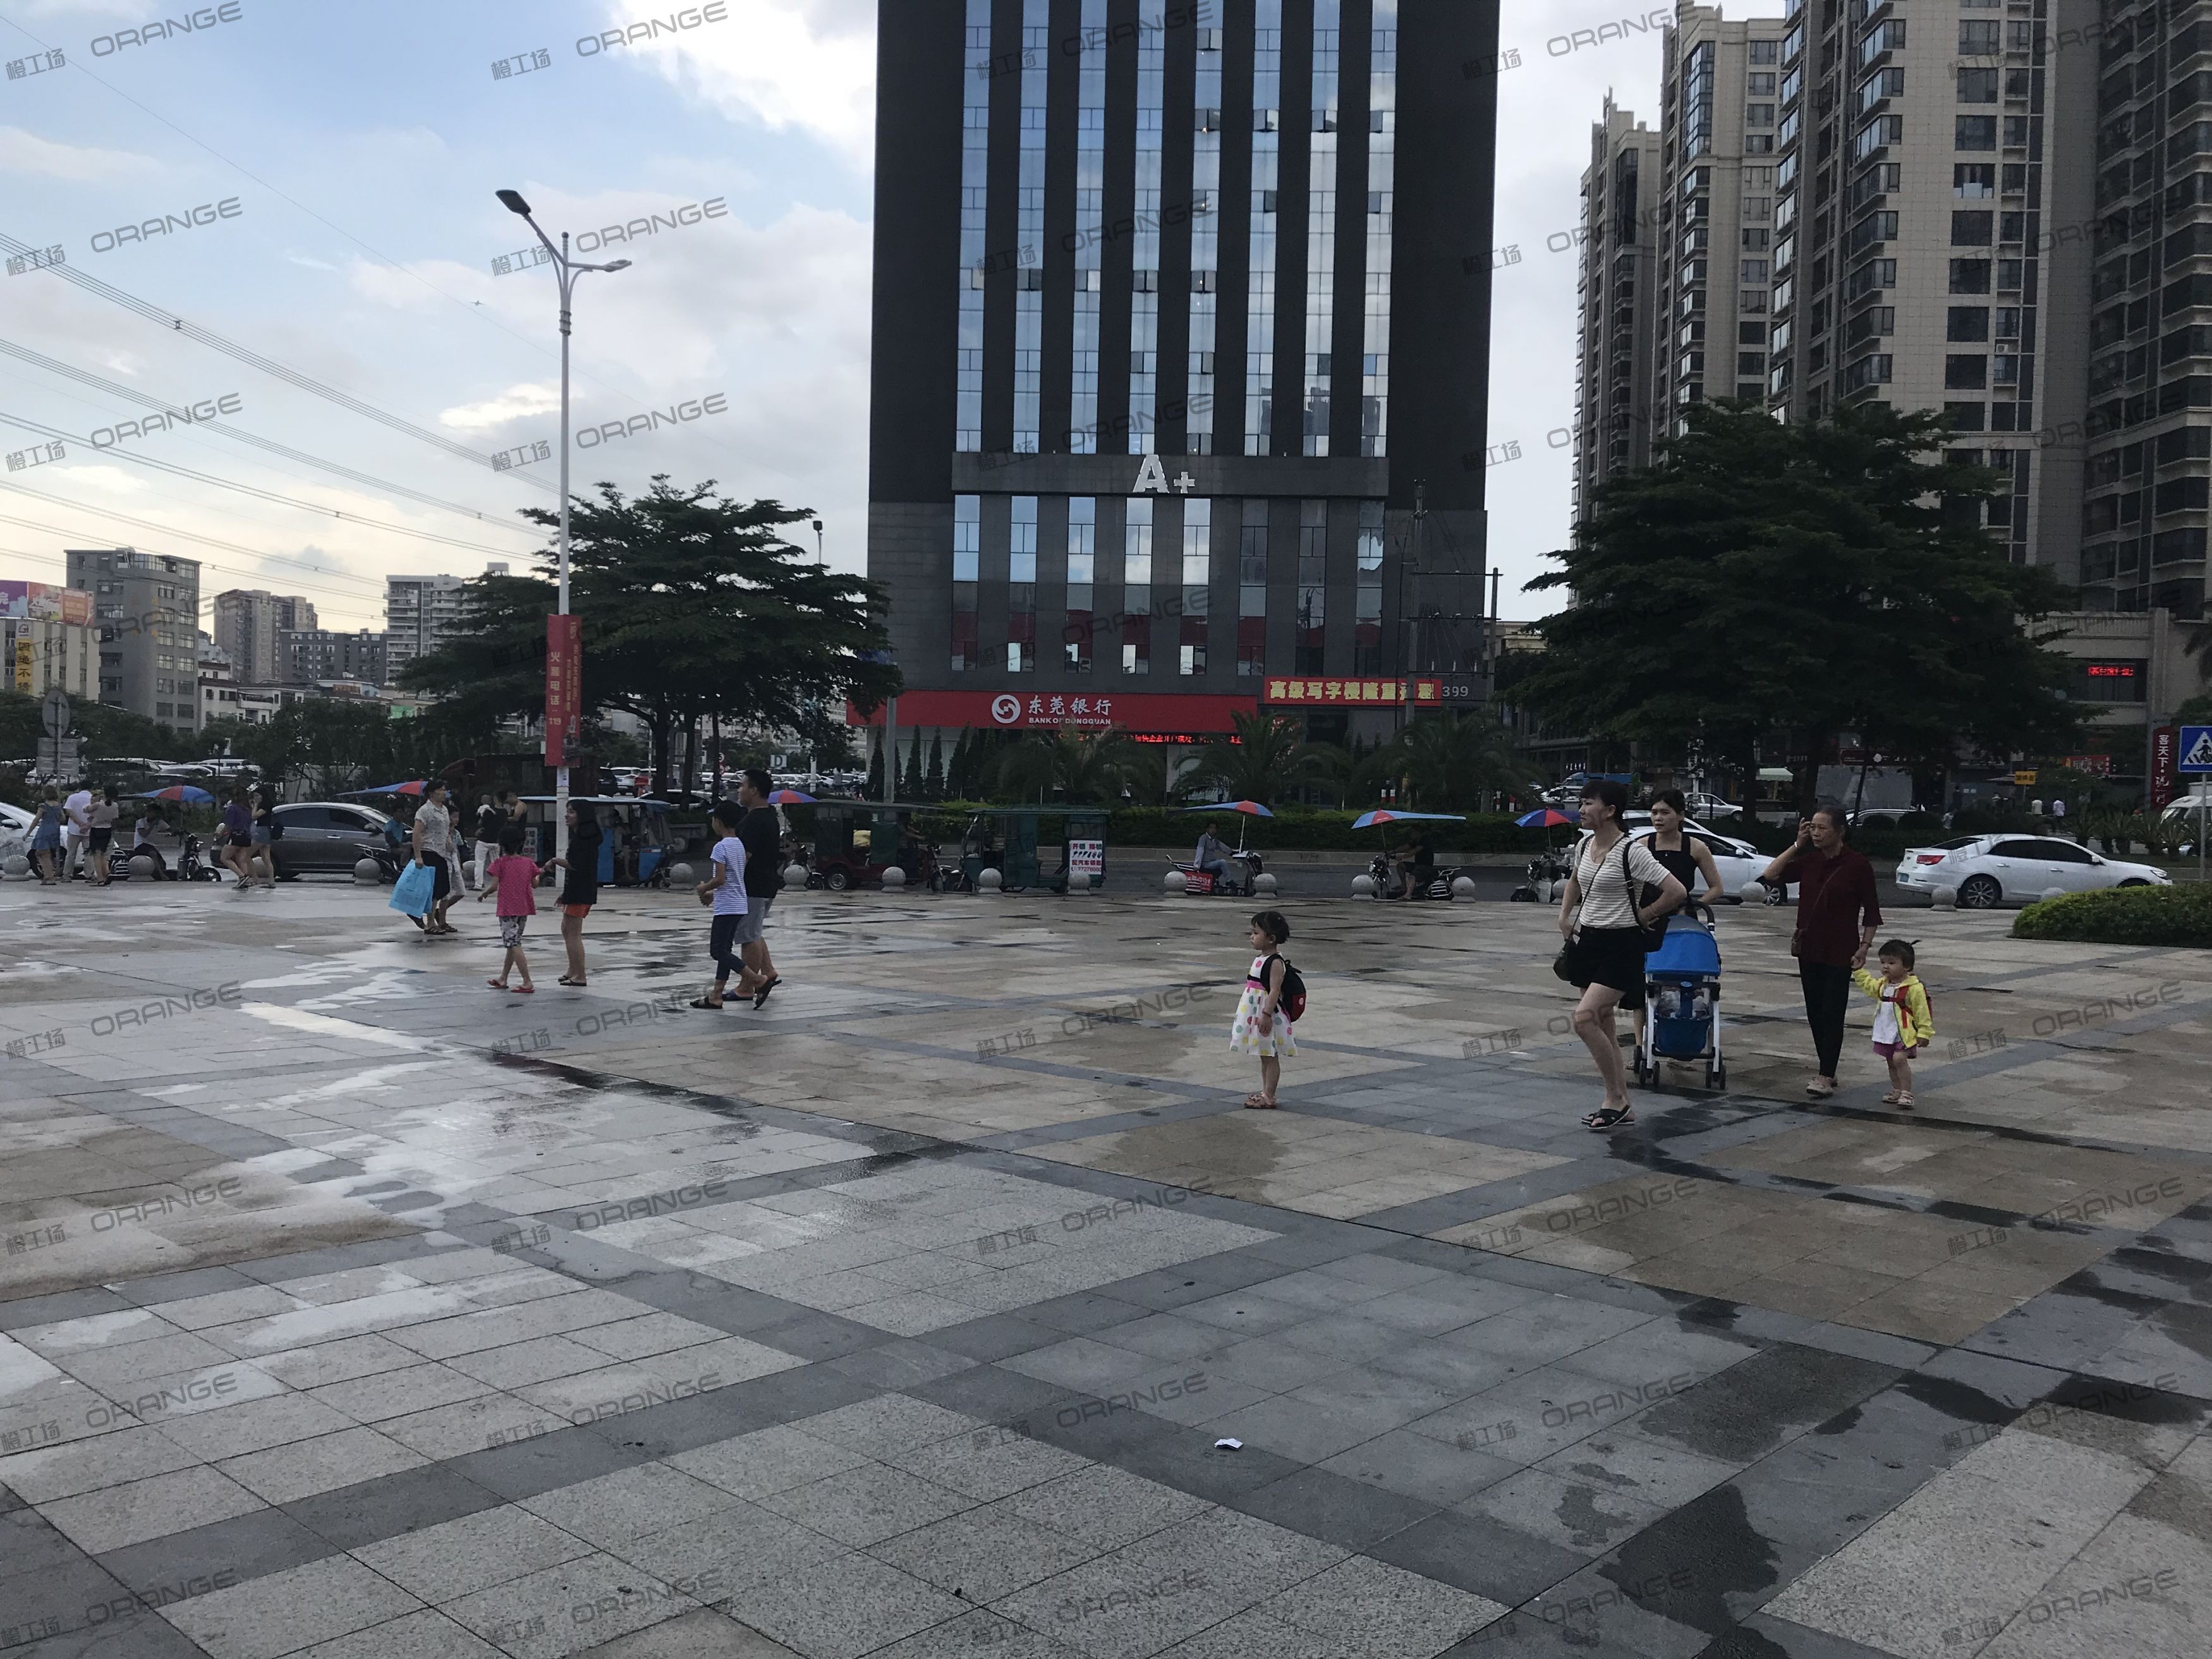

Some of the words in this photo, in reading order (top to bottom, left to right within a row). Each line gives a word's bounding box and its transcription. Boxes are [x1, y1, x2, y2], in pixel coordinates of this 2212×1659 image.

[1442, 686, 1468, 697] 399
[1028, 695, 1112, 715] 东莞银行
[774, 755, 783, 766] D
